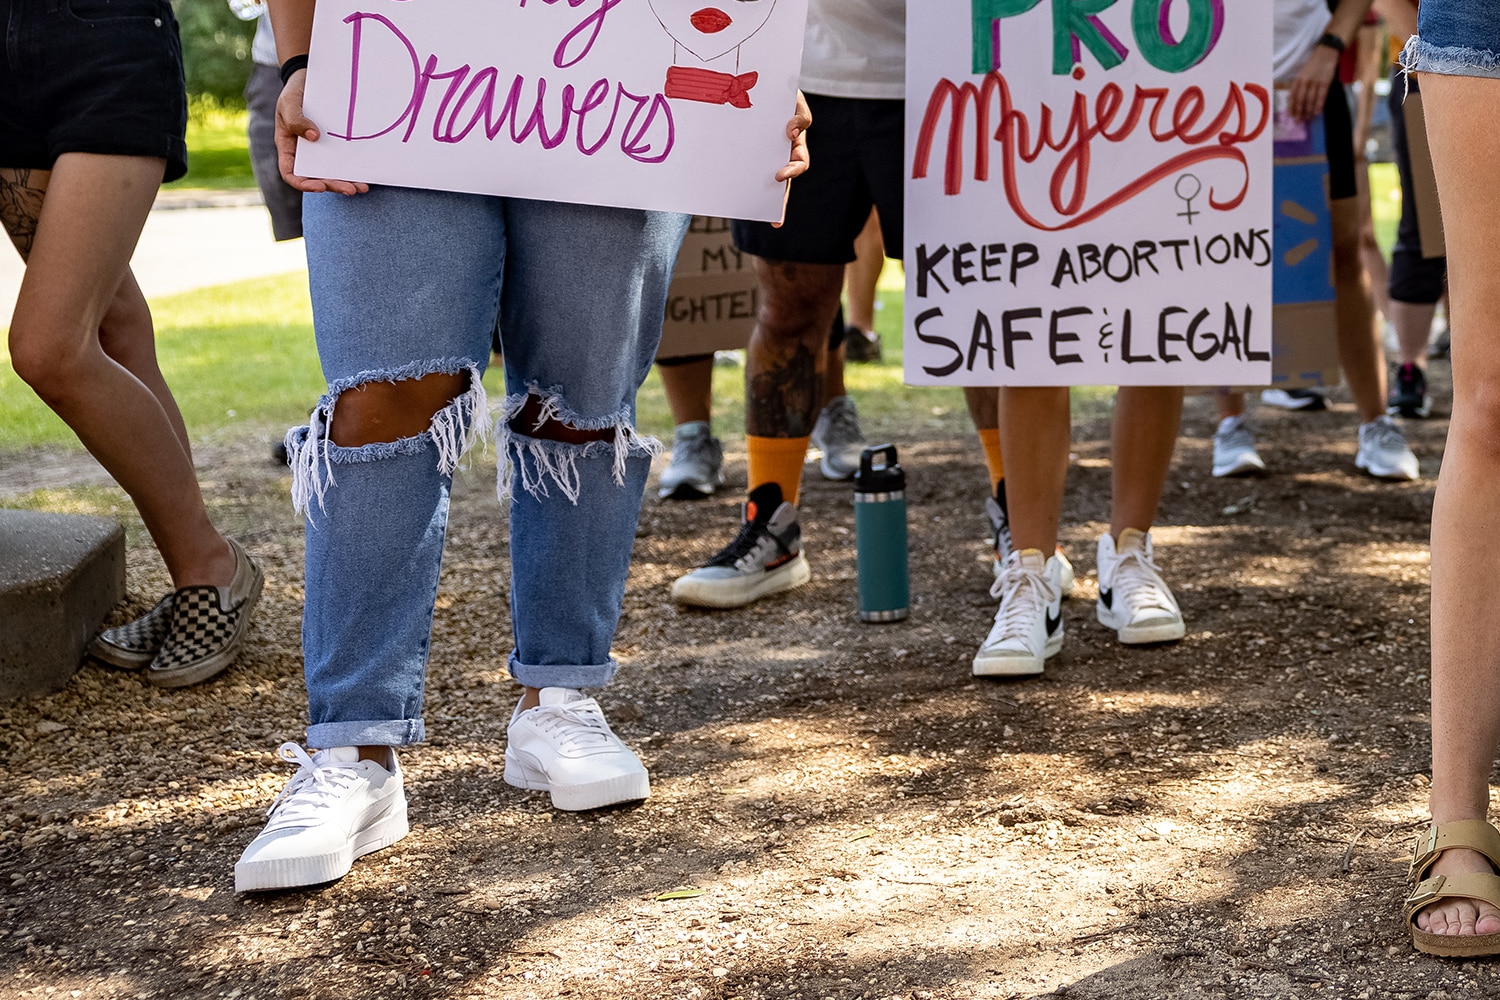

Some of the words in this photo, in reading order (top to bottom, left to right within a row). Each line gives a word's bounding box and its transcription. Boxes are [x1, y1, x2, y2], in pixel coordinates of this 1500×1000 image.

[327, 11, 676, 163] Drawers
[912, 63, 1271, 231] Mujeres
[914, 241, 1040, 299] KEEP
[1051, 228, 1271, 289] ABORTIONS
[914, 305, 1092, 377] SAFE
[1120, 302, 1271, 364] LEGAL
